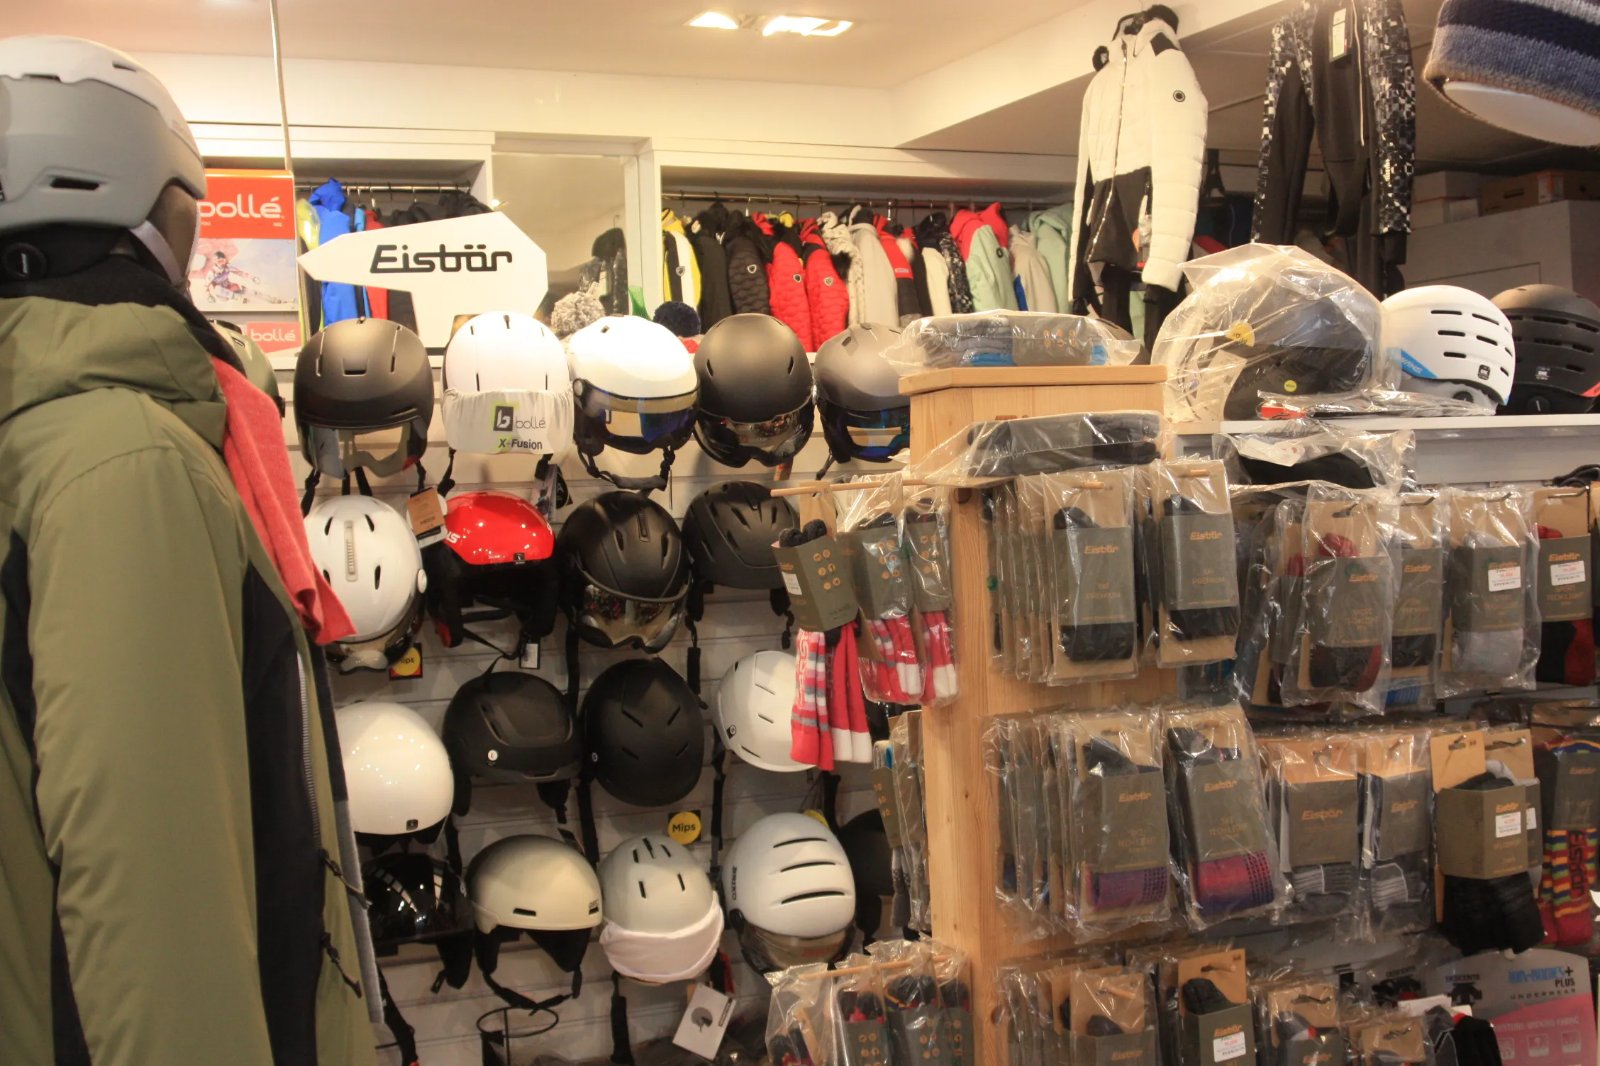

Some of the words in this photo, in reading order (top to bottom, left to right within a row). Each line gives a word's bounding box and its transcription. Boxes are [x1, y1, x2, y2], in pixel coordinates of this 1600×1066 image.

[370, 244, 512, 273] Eisbär
[251, 328, 296, 342] bollé
[515, 416, 547, 429] bollé
[498, 438, 543, 450] X-Fusion
[672, 822, 697, 833] Mips
[1554, 978, 1576, 989] PLUS
[1510, 988, 1577, 999] UNDERWEAR
